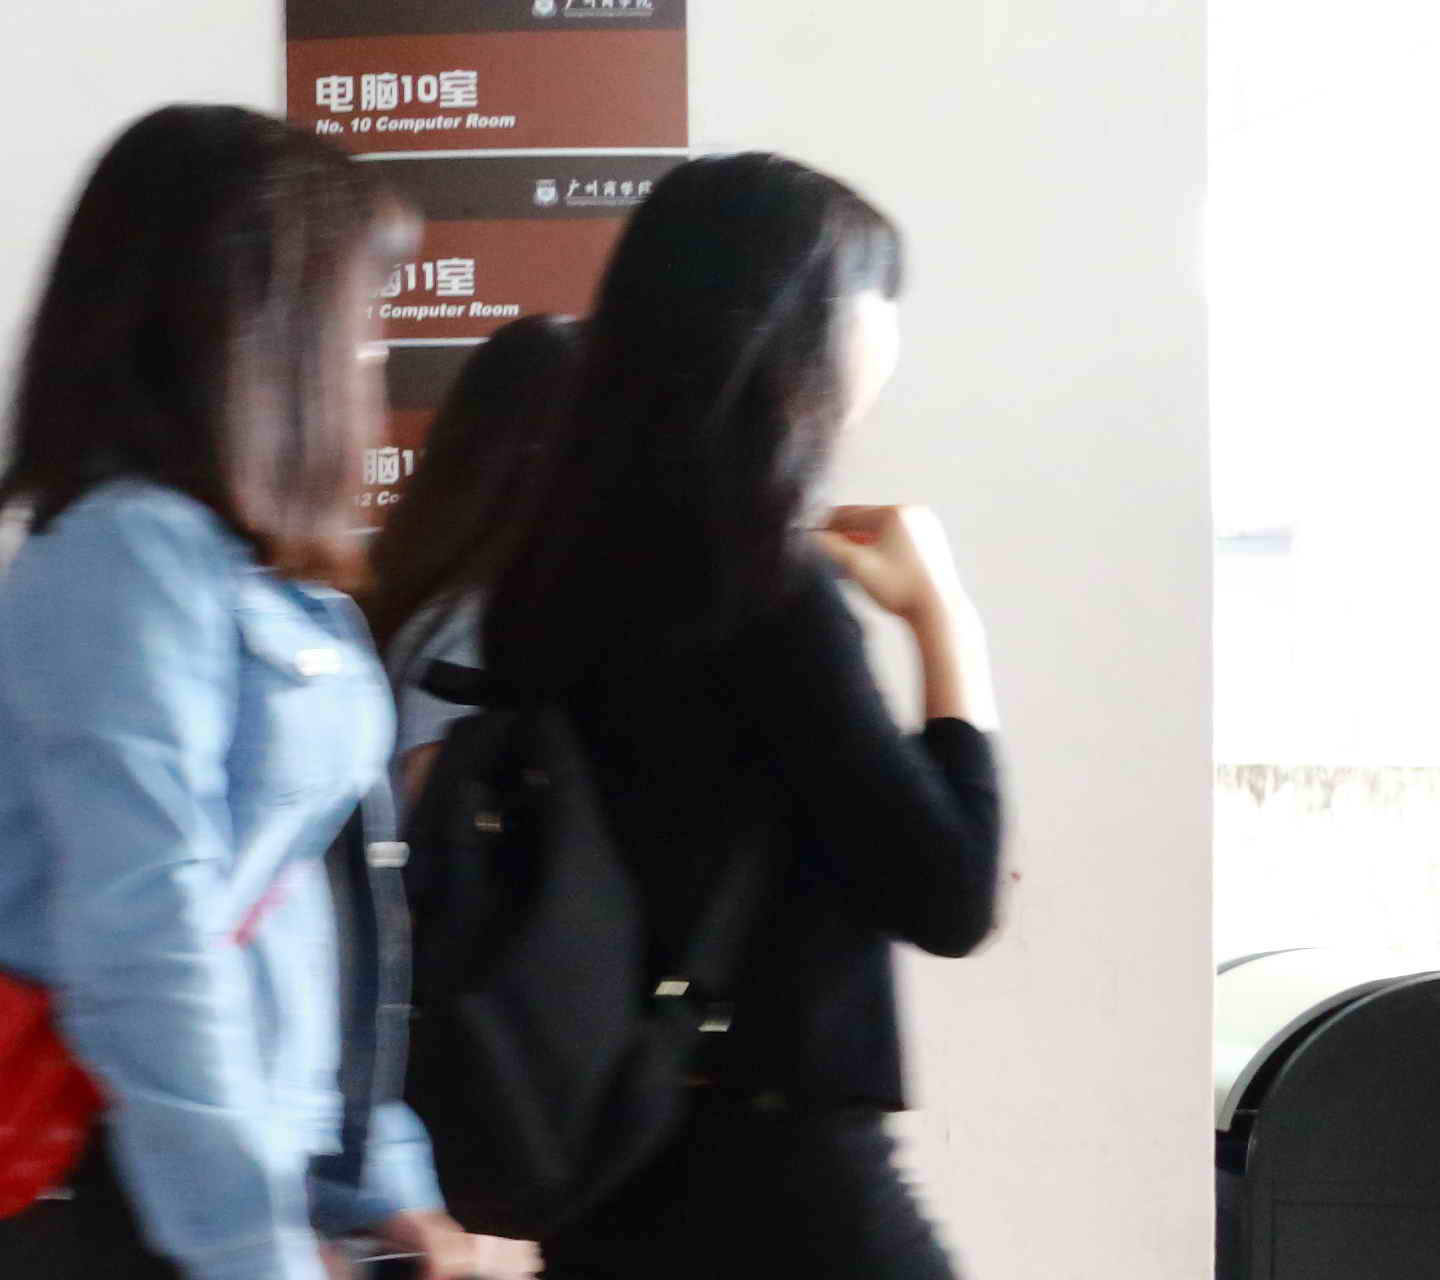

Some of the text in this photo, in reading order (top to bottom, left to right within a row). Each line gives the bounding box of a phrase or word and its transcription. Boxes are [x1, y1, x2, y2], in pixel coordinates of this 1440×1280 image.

[315, 69, 478, 113] 电脑10室
[315, 112, 516, 135] No. 10 Computer Room
[379, 302, 467, 320] Computer
[469, 300, 520, 318] Room
